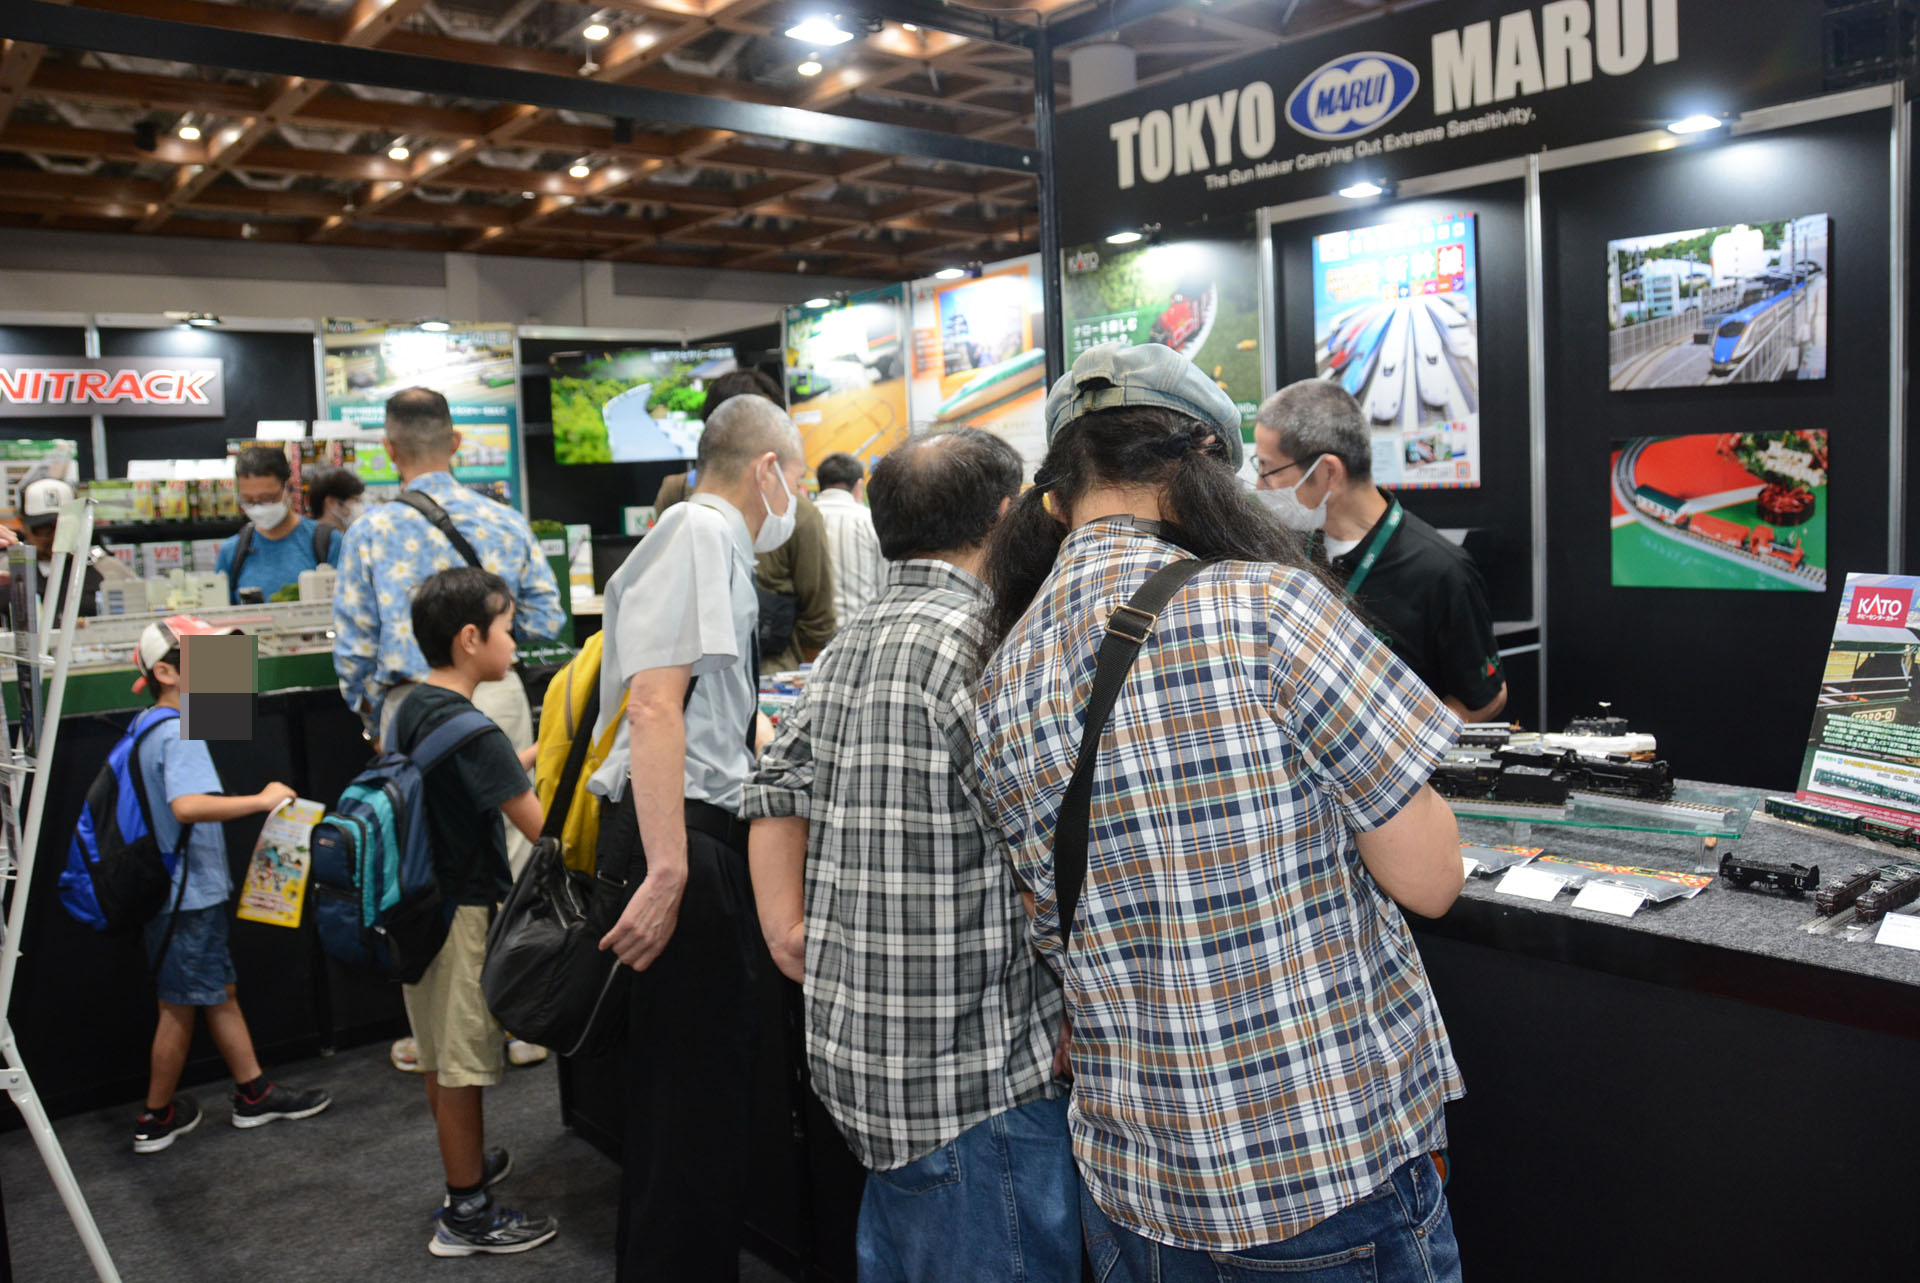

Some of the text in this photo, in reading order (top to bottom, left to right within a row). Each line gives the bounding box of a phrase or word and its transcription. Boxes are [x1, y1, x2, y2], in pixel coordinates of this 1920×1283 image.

[1110, 0, 1679, 190] TOKYO MARUI
[1315, 73, 1387, 117] MARUI
[1204, 106, 1536, 191] The Gun Maker Carrying Out Extreme Sensitivity.
[1857, 592, 1902, 616] KATO
